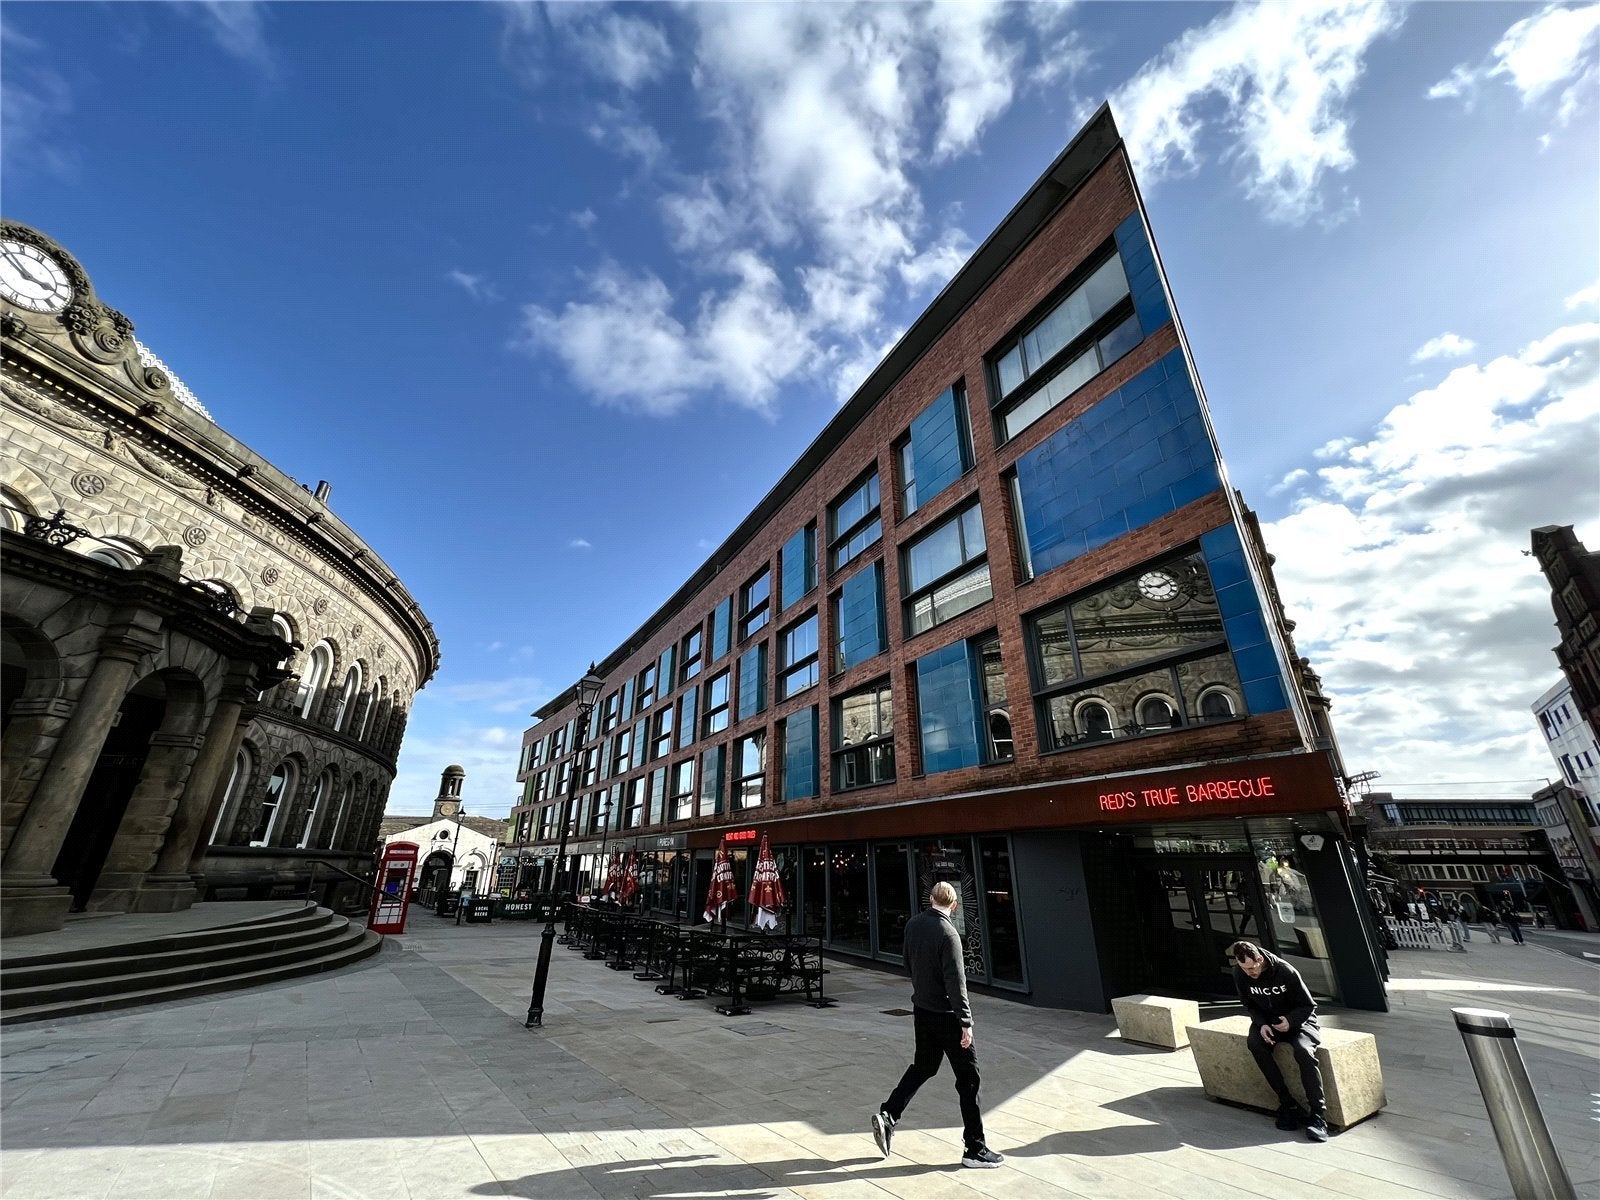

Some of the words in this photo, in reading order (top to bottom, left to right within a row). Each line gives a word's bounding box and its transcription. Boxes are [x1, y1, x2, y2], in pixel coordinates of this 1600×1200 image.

[1100, 791, 1137, 811] RED'S
[1141, 787, 1180, 807] TRUE
[1186, 776, 1275, 803] BARBECUE
[505, 903, 532, 911] HONEST
[1250, 984, 1287, 996] NICCE
